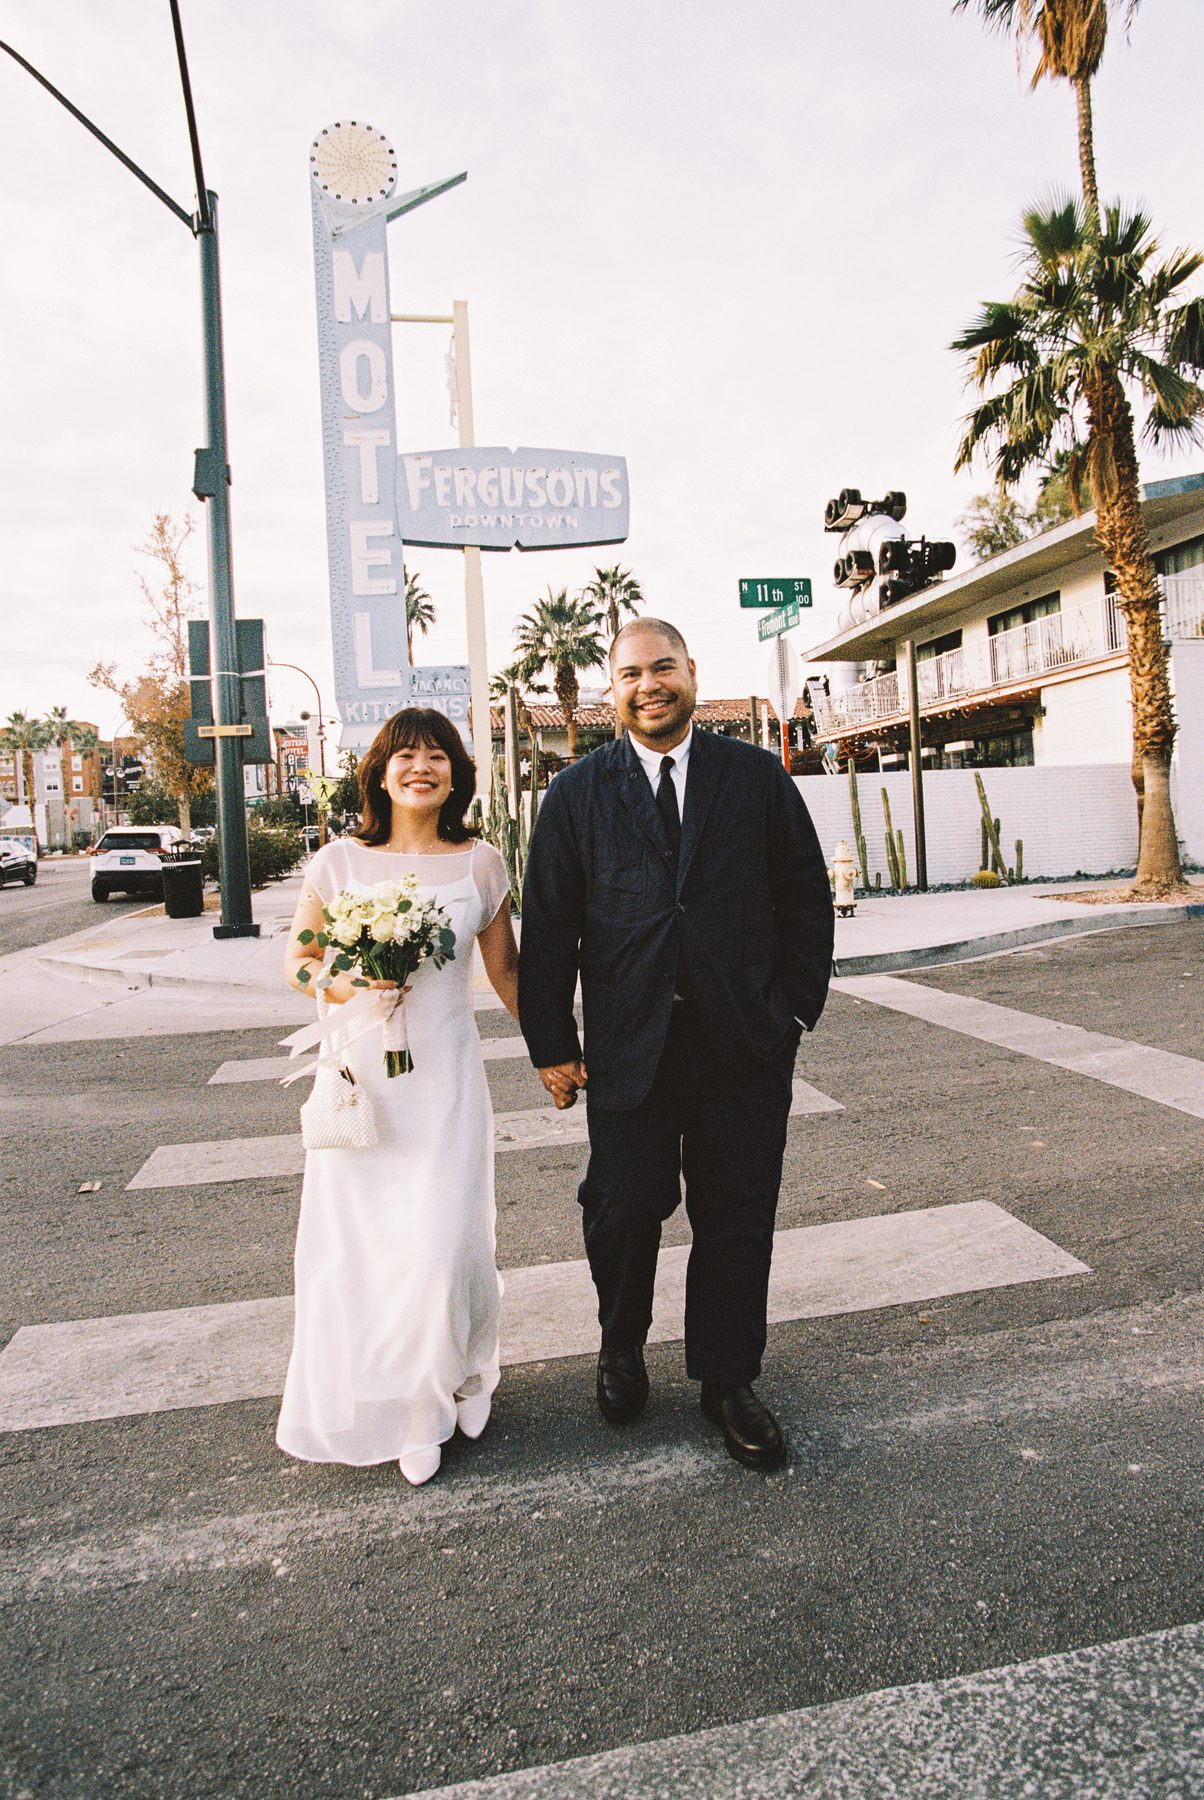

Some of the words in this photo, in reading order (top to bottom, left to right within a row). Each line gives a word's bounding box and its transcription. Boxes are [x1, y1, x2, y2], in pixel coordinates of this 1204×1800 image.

[333, 251, 401, 687] MOTEL
[450, 514, 579, 529] DOWNTOWN
[741, 581, 748, 592] N
[794, 581, 804, 591] ST
[796, 595, 809, 604] 100
[411, 678, 469, 693] VACANCY
